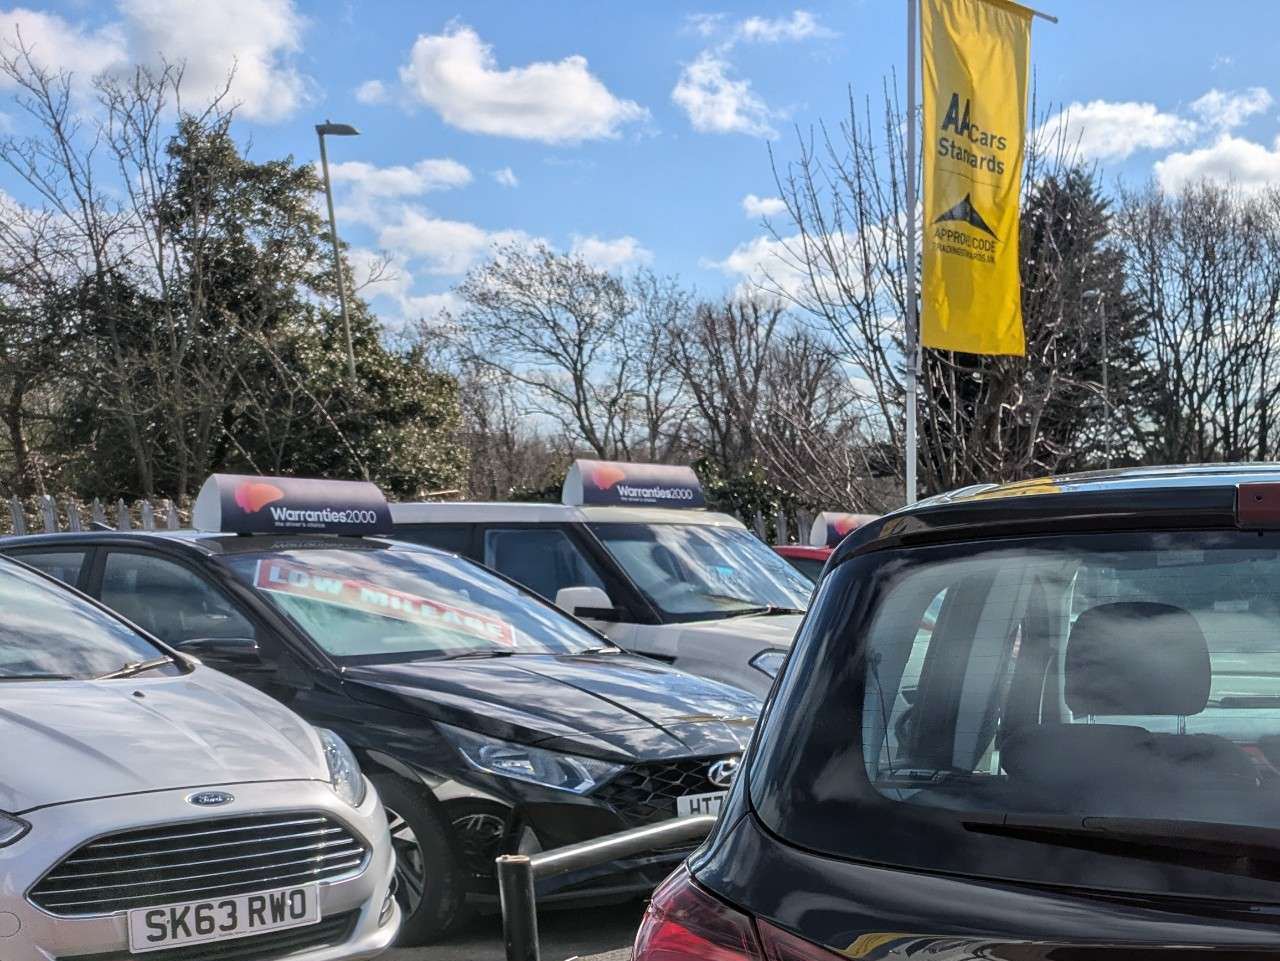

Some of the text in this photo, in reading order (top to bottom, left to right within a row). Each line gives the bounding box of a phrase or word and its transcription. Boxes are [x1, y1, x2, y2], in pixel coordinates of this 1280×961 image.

[617, 485, 694, 500] Warranties2000
[270, 507, 377, 524] Warranties2000
[269, 565, 343, 594] LOW
[145, 889, 306, 942] SK63 RWO
